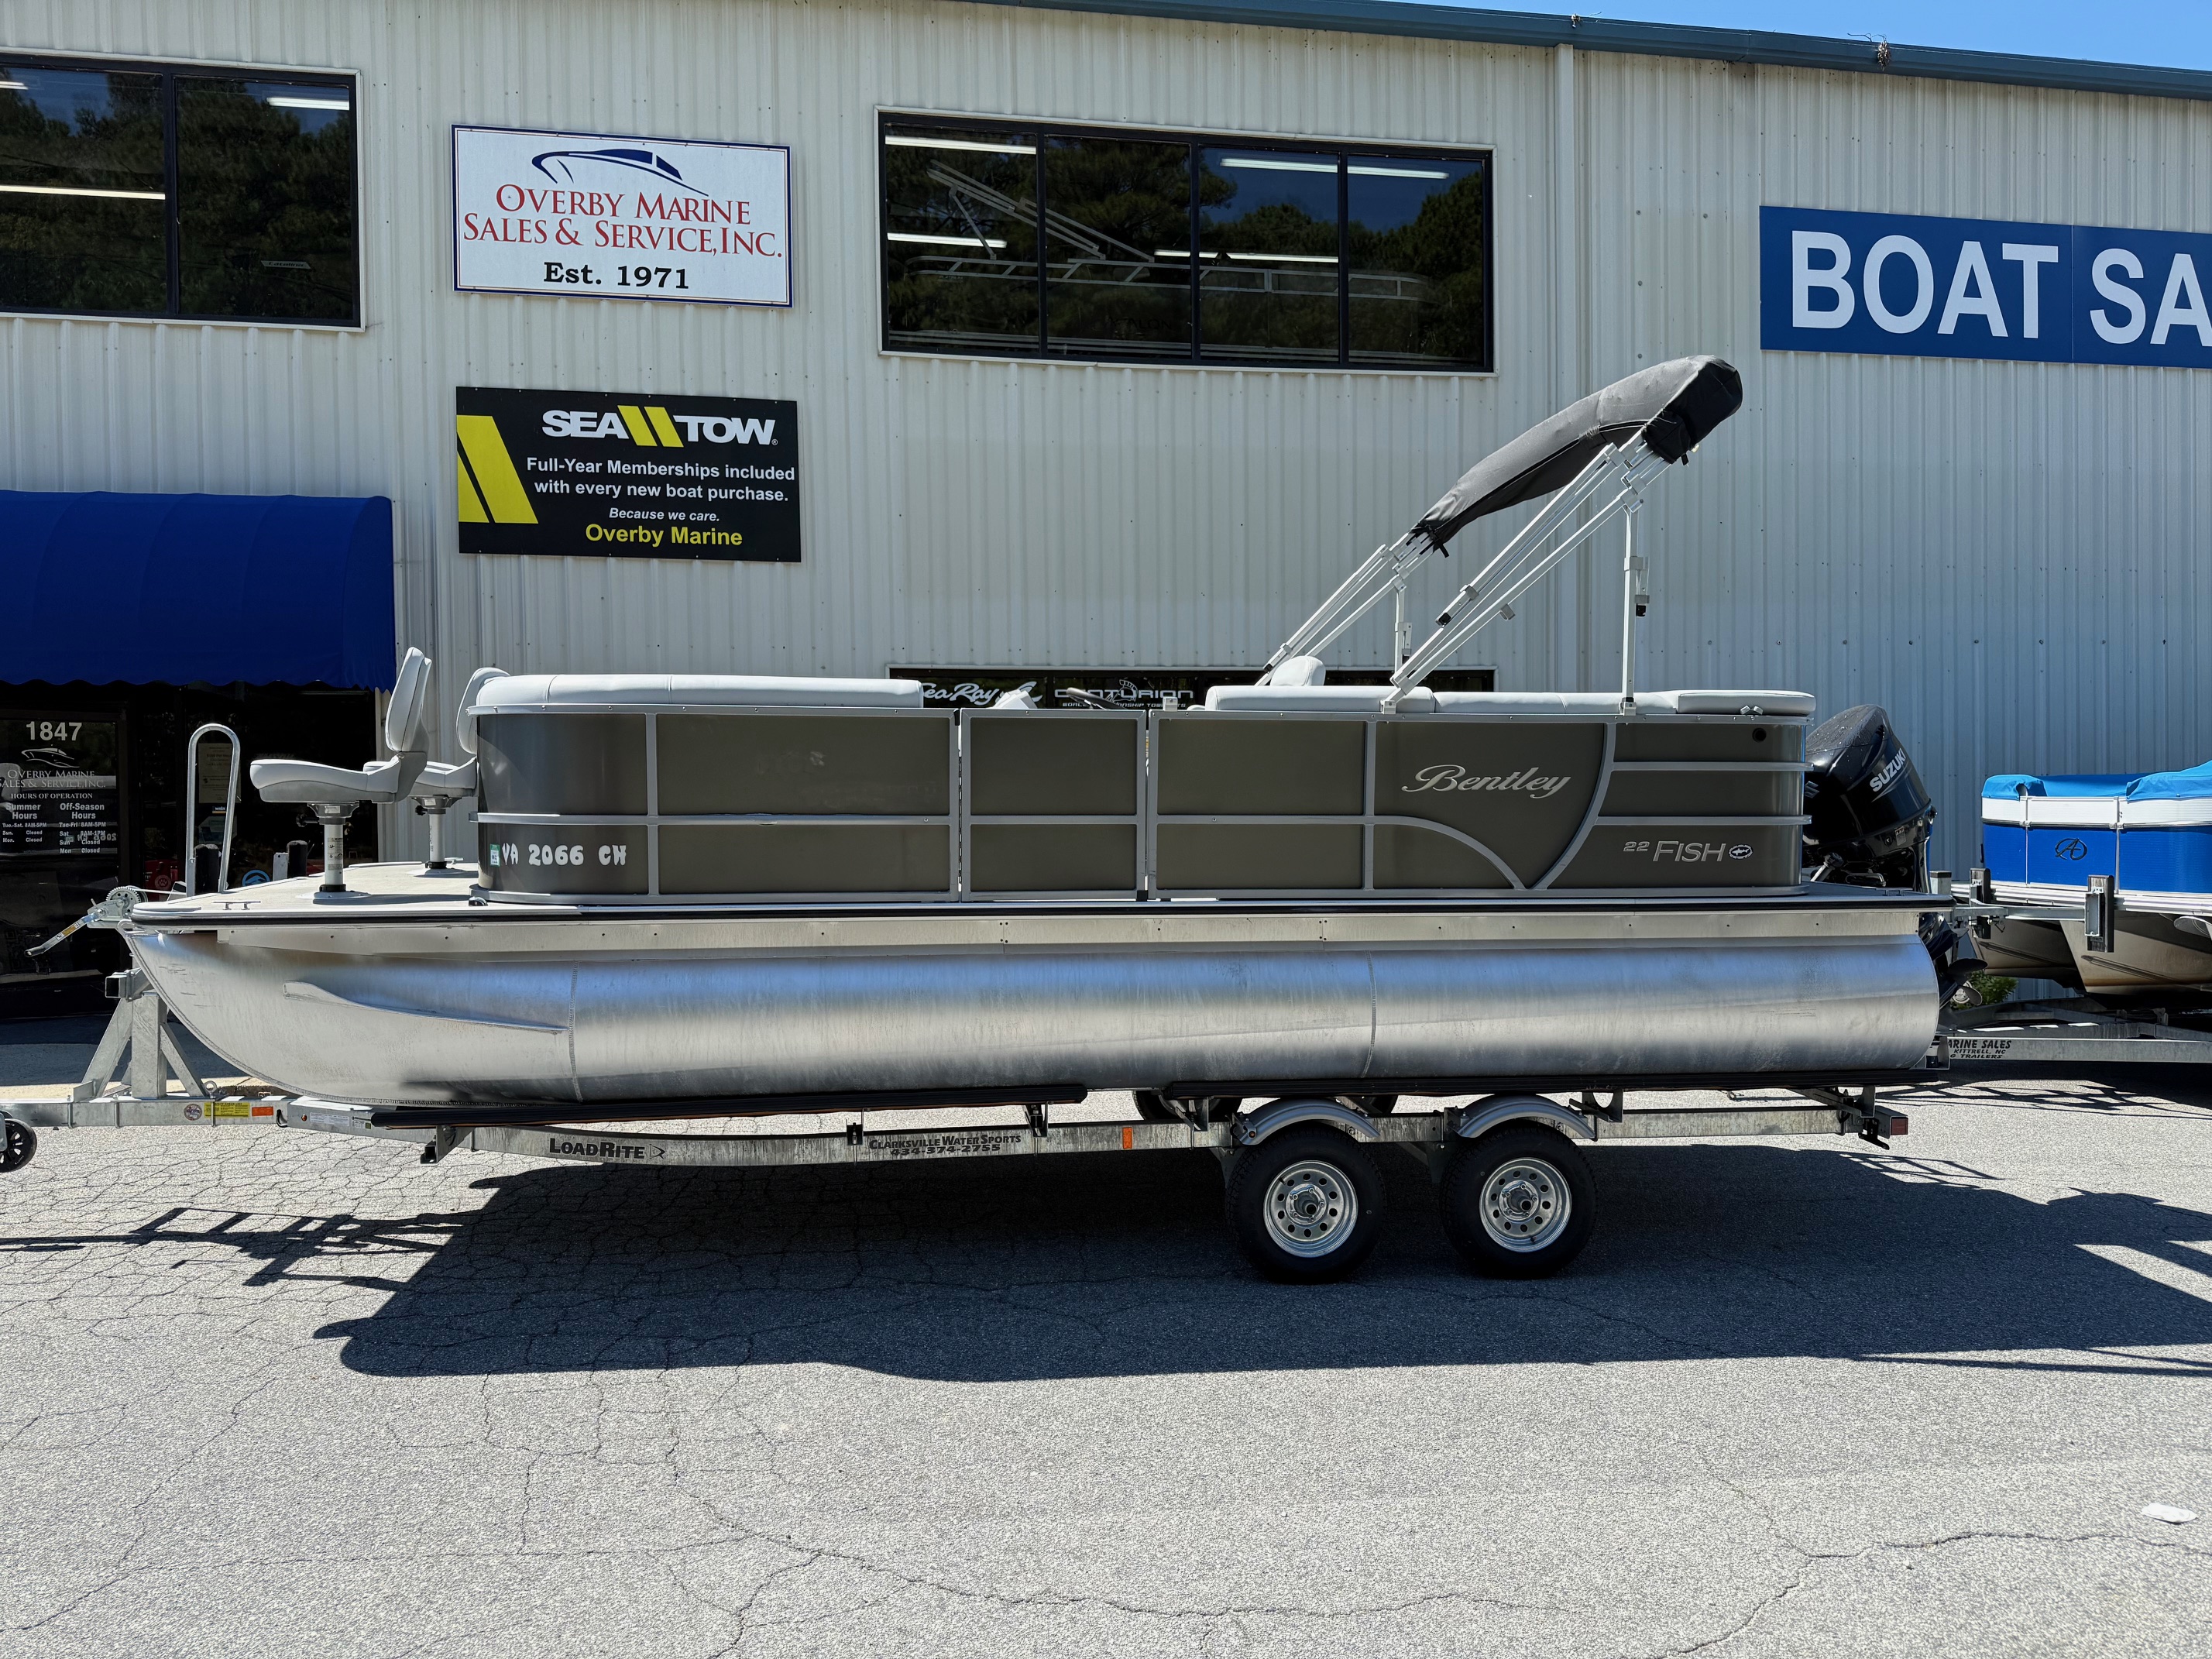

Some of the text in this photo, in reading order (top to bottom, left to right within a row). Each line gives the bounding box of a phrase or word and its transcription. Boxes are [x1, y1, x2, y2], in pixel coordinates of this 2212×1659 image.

[496, 184, 750, 225] OVERBY MARINE
[463, 214, 548, 243] SALES
[555, 218, 584, 246] &
[544, 262, 689, 290] Est. 1971
[1791, 230, 2212, 347] BOAT SA
[541, 410, 630, 439] SEA
[527, 457, 795, 481] Full-Year Memberships included
[534, 479, 788, 502] with every new boat purchase.
[609, 507, 720, 522] Because we care.
[586, 524, 743, 548] Overby Marine
[950, 683, 999, 706] Ray
[1054, 689, 1194, 699] CNTURION
[26, 721, 82, 740] 1847
[8, 770, 94, 778] OVERBY MARINE
[1869, 747, 1907, 792] SUZUKI
[0, 779, 26, 788] ALES
[1401, 764, 1571, 799] Bentley
[60, 802, 105, 811] Off-Season
[71, 811, 96, 819] Hours
[502, 843, 519, 865] VA
[528, 843, 584, 866] 2066
[598, 844, 627, 866] CH
[1623, 840, 1726, 863] 22 FISH
[1948, 1039, 2012, 1049] ARINE SALES
[869, 1134, 1022, 1149] CLARKSVILLE WATER SPORTS
[890, 1144, 1001, 1156] 434-374-2755
